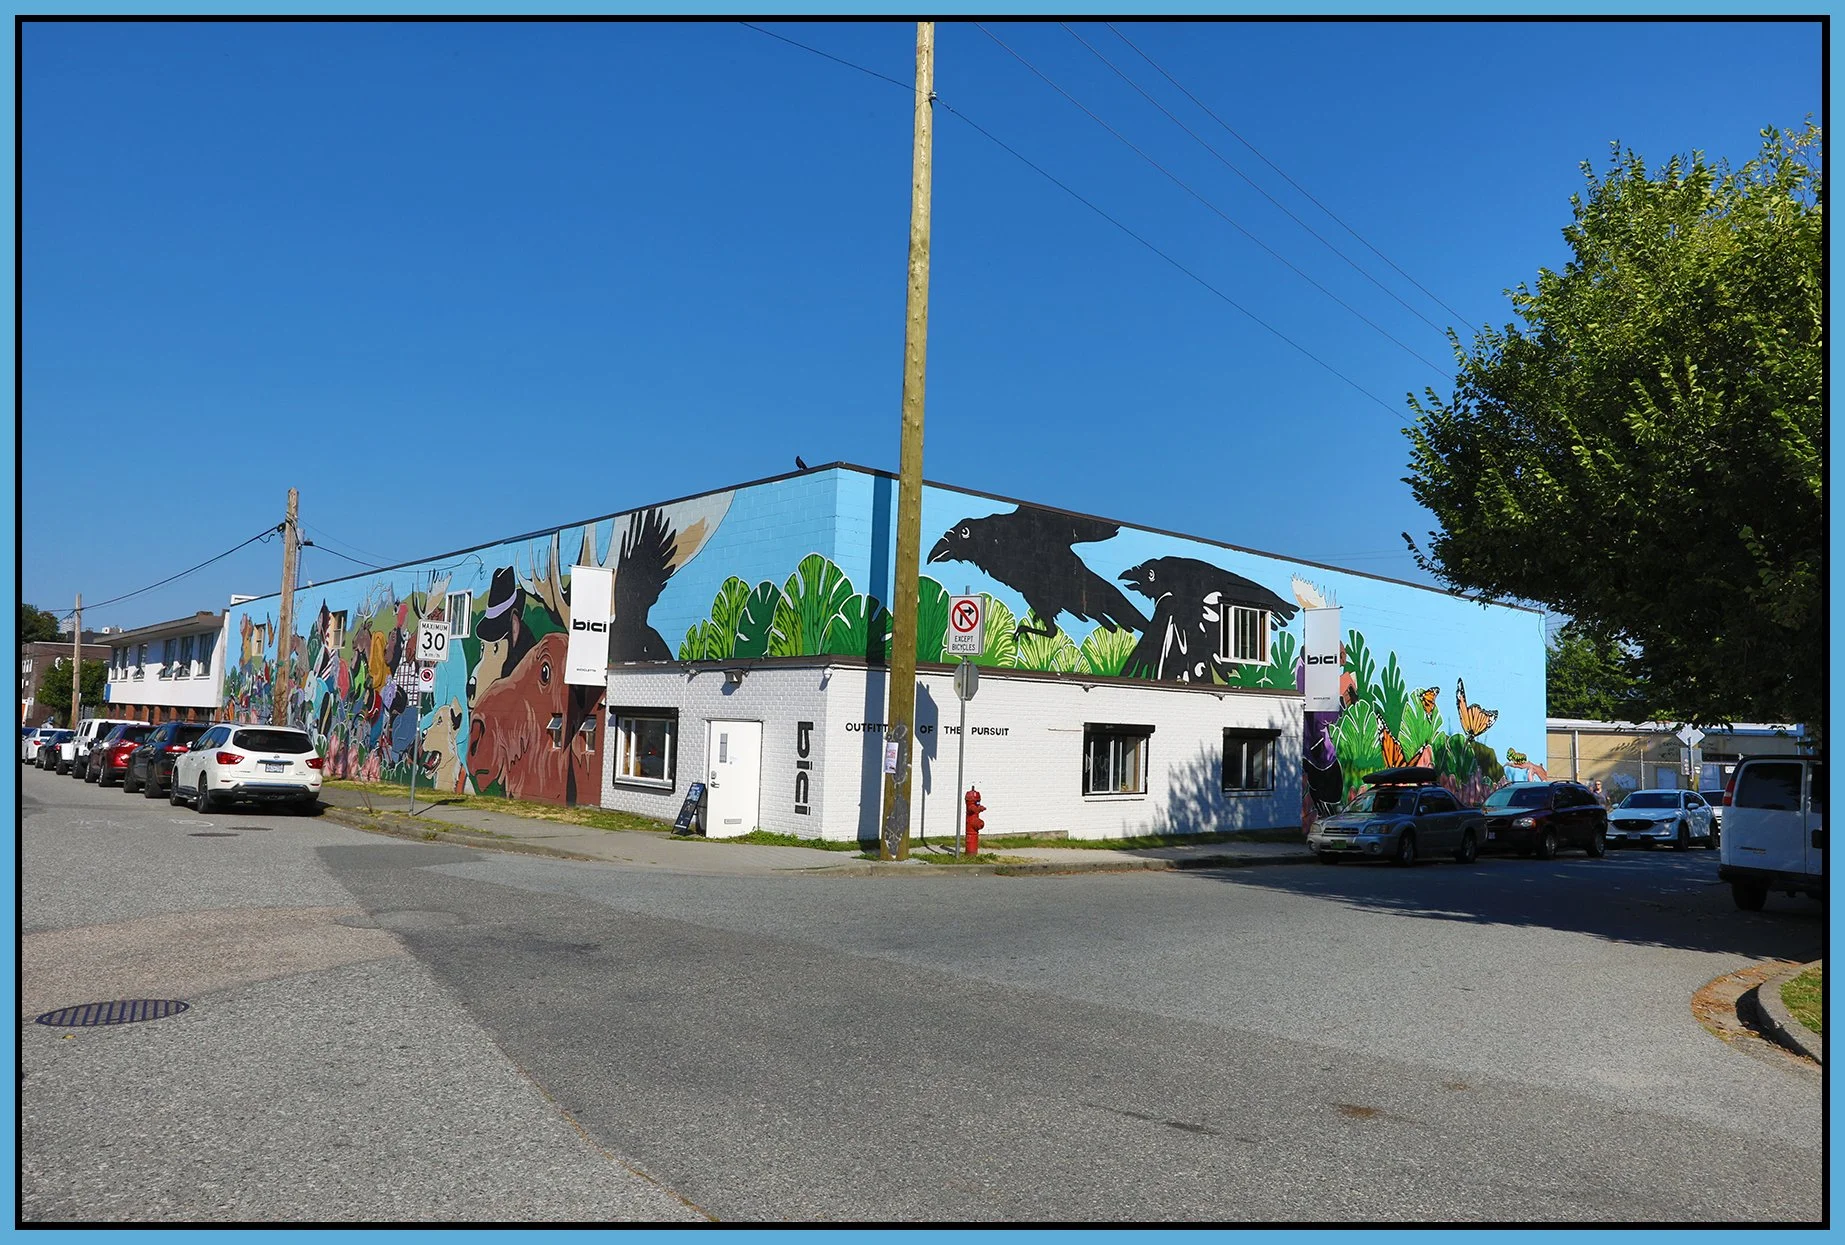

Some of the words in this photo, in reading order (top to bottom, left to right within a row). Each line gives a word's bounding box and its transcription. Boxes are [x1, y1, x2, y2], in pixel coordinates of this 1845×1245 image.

[421, 622, 448, 632] MAXIMUM
[573, 618, 607, 633] bici
[422, 632, 445, 651] 30
[955, 635, 974, 643] EXCEPT
[951, 643, 976, 652] BICYCLES
[1307, 654, 1338, 665] bici
[845, 722, 889, 733] OUTFITT
[919, 725, 934, 734] OF
[944, 725, 961, 735] THE
[971, 726, 1010, 736] PURSUIT
[795, 721, 814, 816] bici
